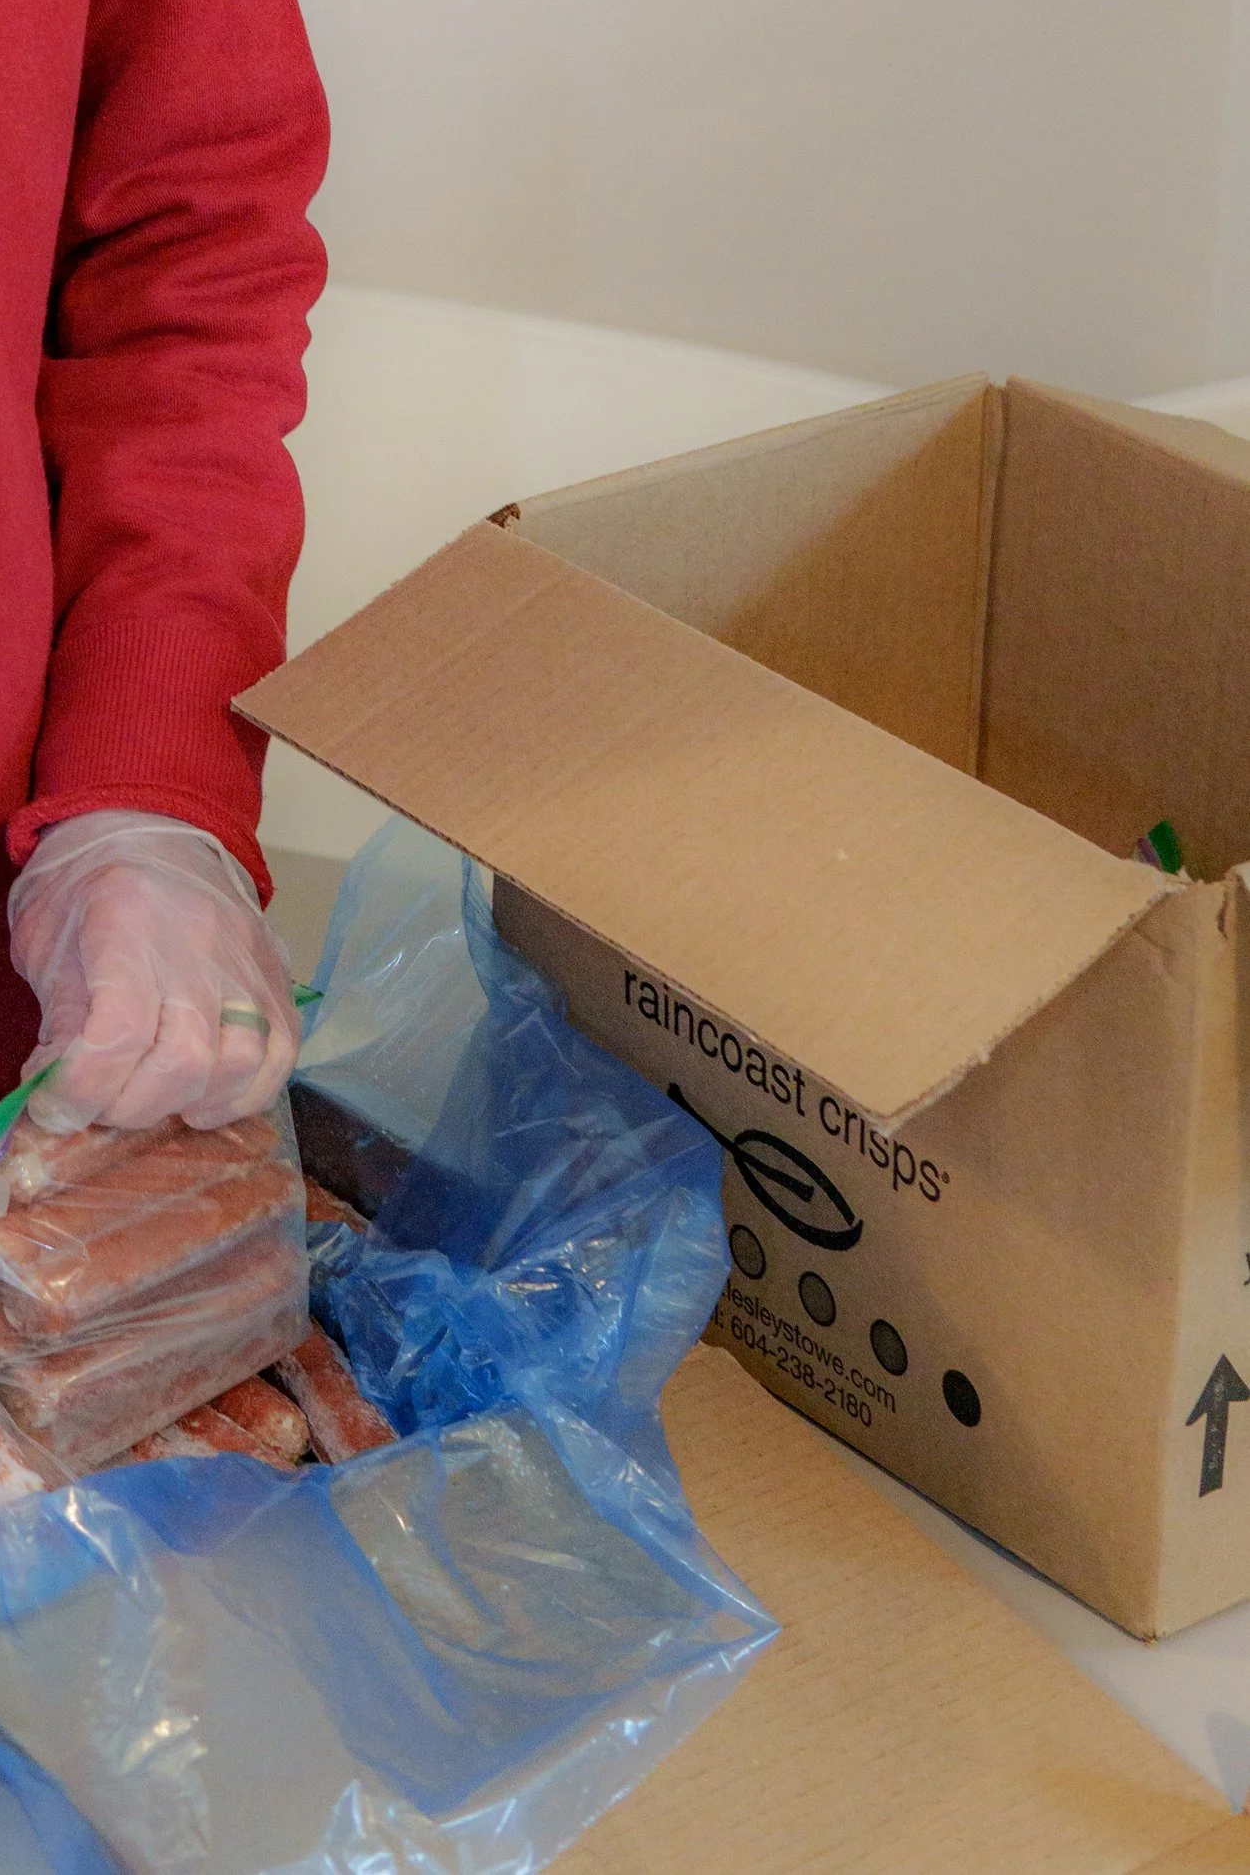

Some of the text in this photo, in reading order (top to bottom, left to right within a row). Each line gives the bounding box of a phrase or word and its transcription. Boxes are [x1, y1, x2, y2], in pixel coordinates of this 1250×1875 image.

[624, 969, 806, 1117] raincoast
[720, 1277, 896, 1414] .lesleystowe.com
[730, 1315, 872, 1427] 604-238-2180
